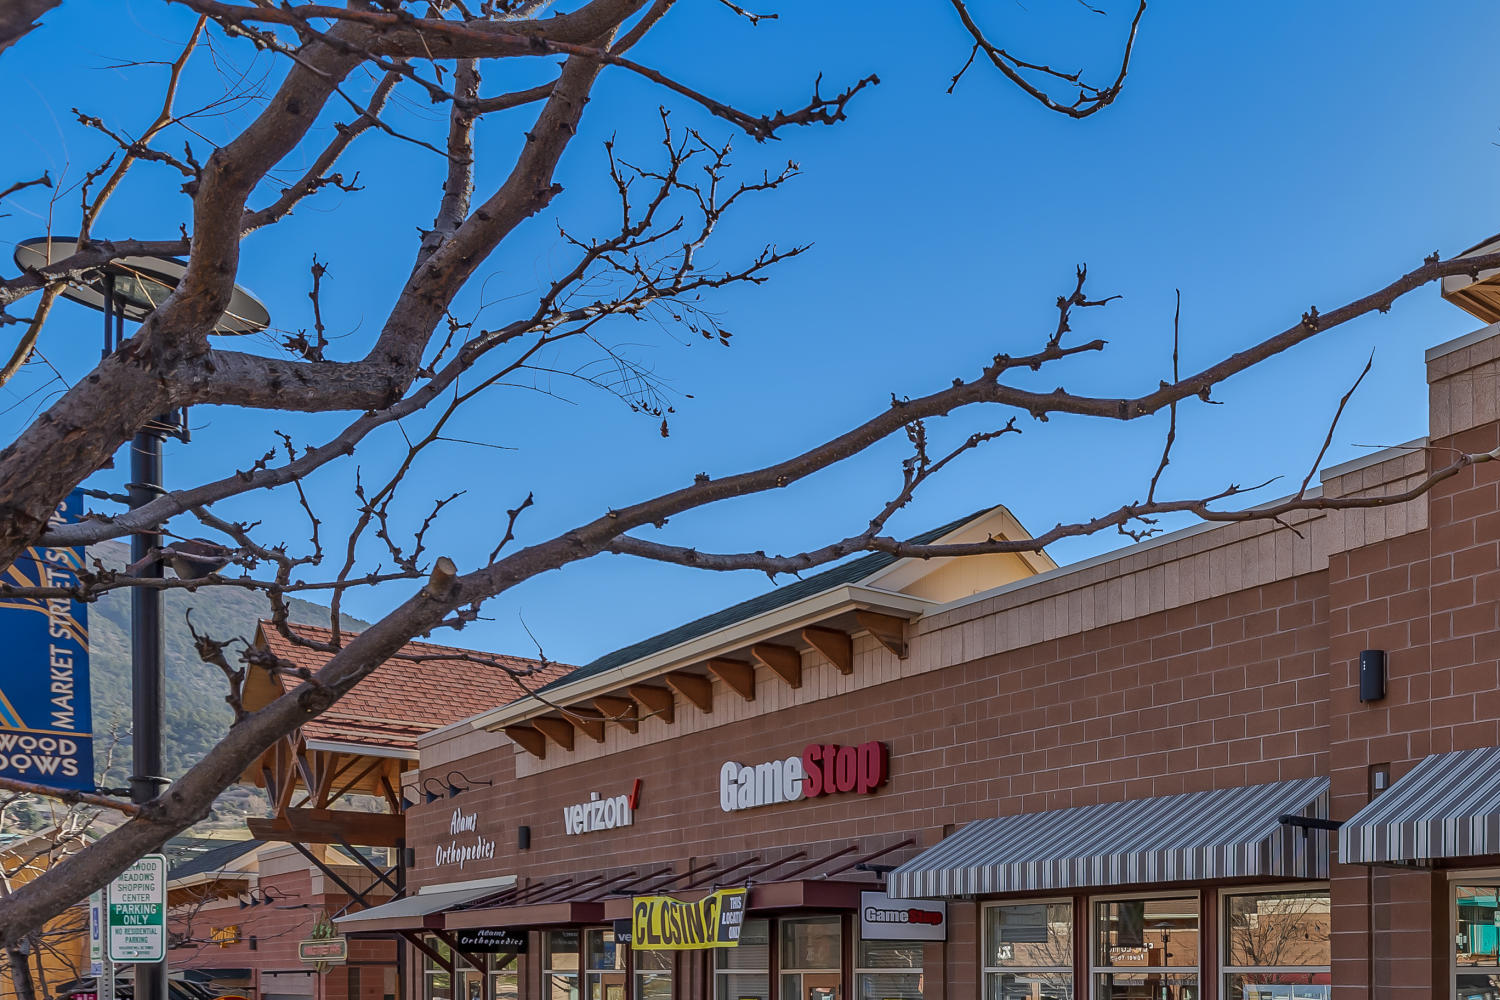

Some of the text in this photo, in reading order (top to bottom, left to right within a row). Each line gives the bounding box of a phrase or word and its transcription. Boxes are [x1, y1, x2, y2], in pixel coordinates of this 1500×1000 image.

[50, 643, 75, 730] MARKET
[719, 740, 887, 812] GameStop
[450, 807, 478, 837] Adams
[563, 791, 633, 836] verizon
[435, 835, 496, 870] Orthopaedics
[117, 883, 155, 892] SHOPPING
[121, 894, 150, 902] CENTER
[115, 904, 157, 915] PARKING
[123, 915, 149, 925] ONLY
[635, 897, 717, 945] CLOSING
[461, 936, 523, 946] Orthopaedics
